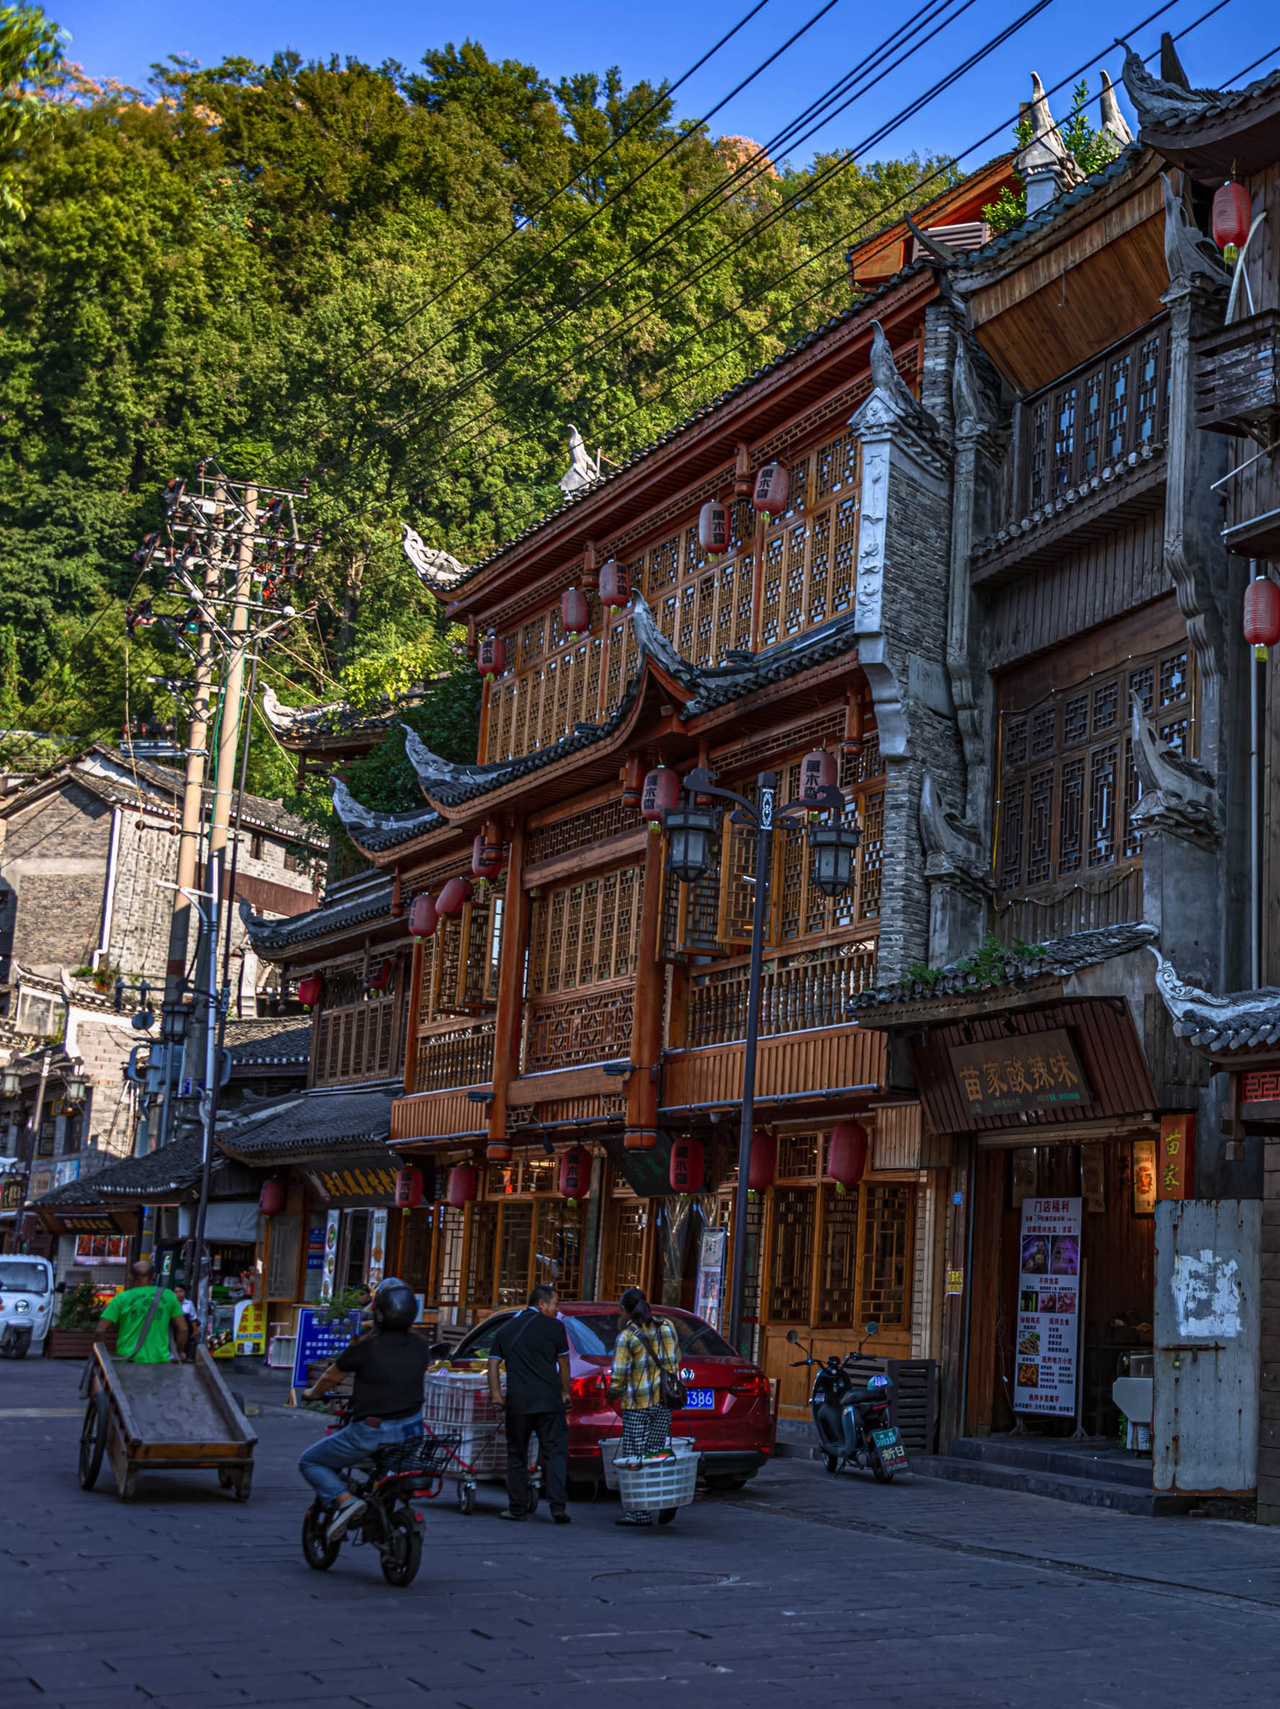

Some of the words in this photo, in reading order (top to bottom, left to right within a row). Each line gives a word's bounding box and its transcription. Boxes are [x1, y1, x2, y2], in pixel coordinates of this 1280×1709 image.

[959, 1050, 1080, 1103] 苗家酸辣味
[1163, 1129, 1182, 1200] 苗家
[1034, 1200, 1070, 1213] 门店福利
